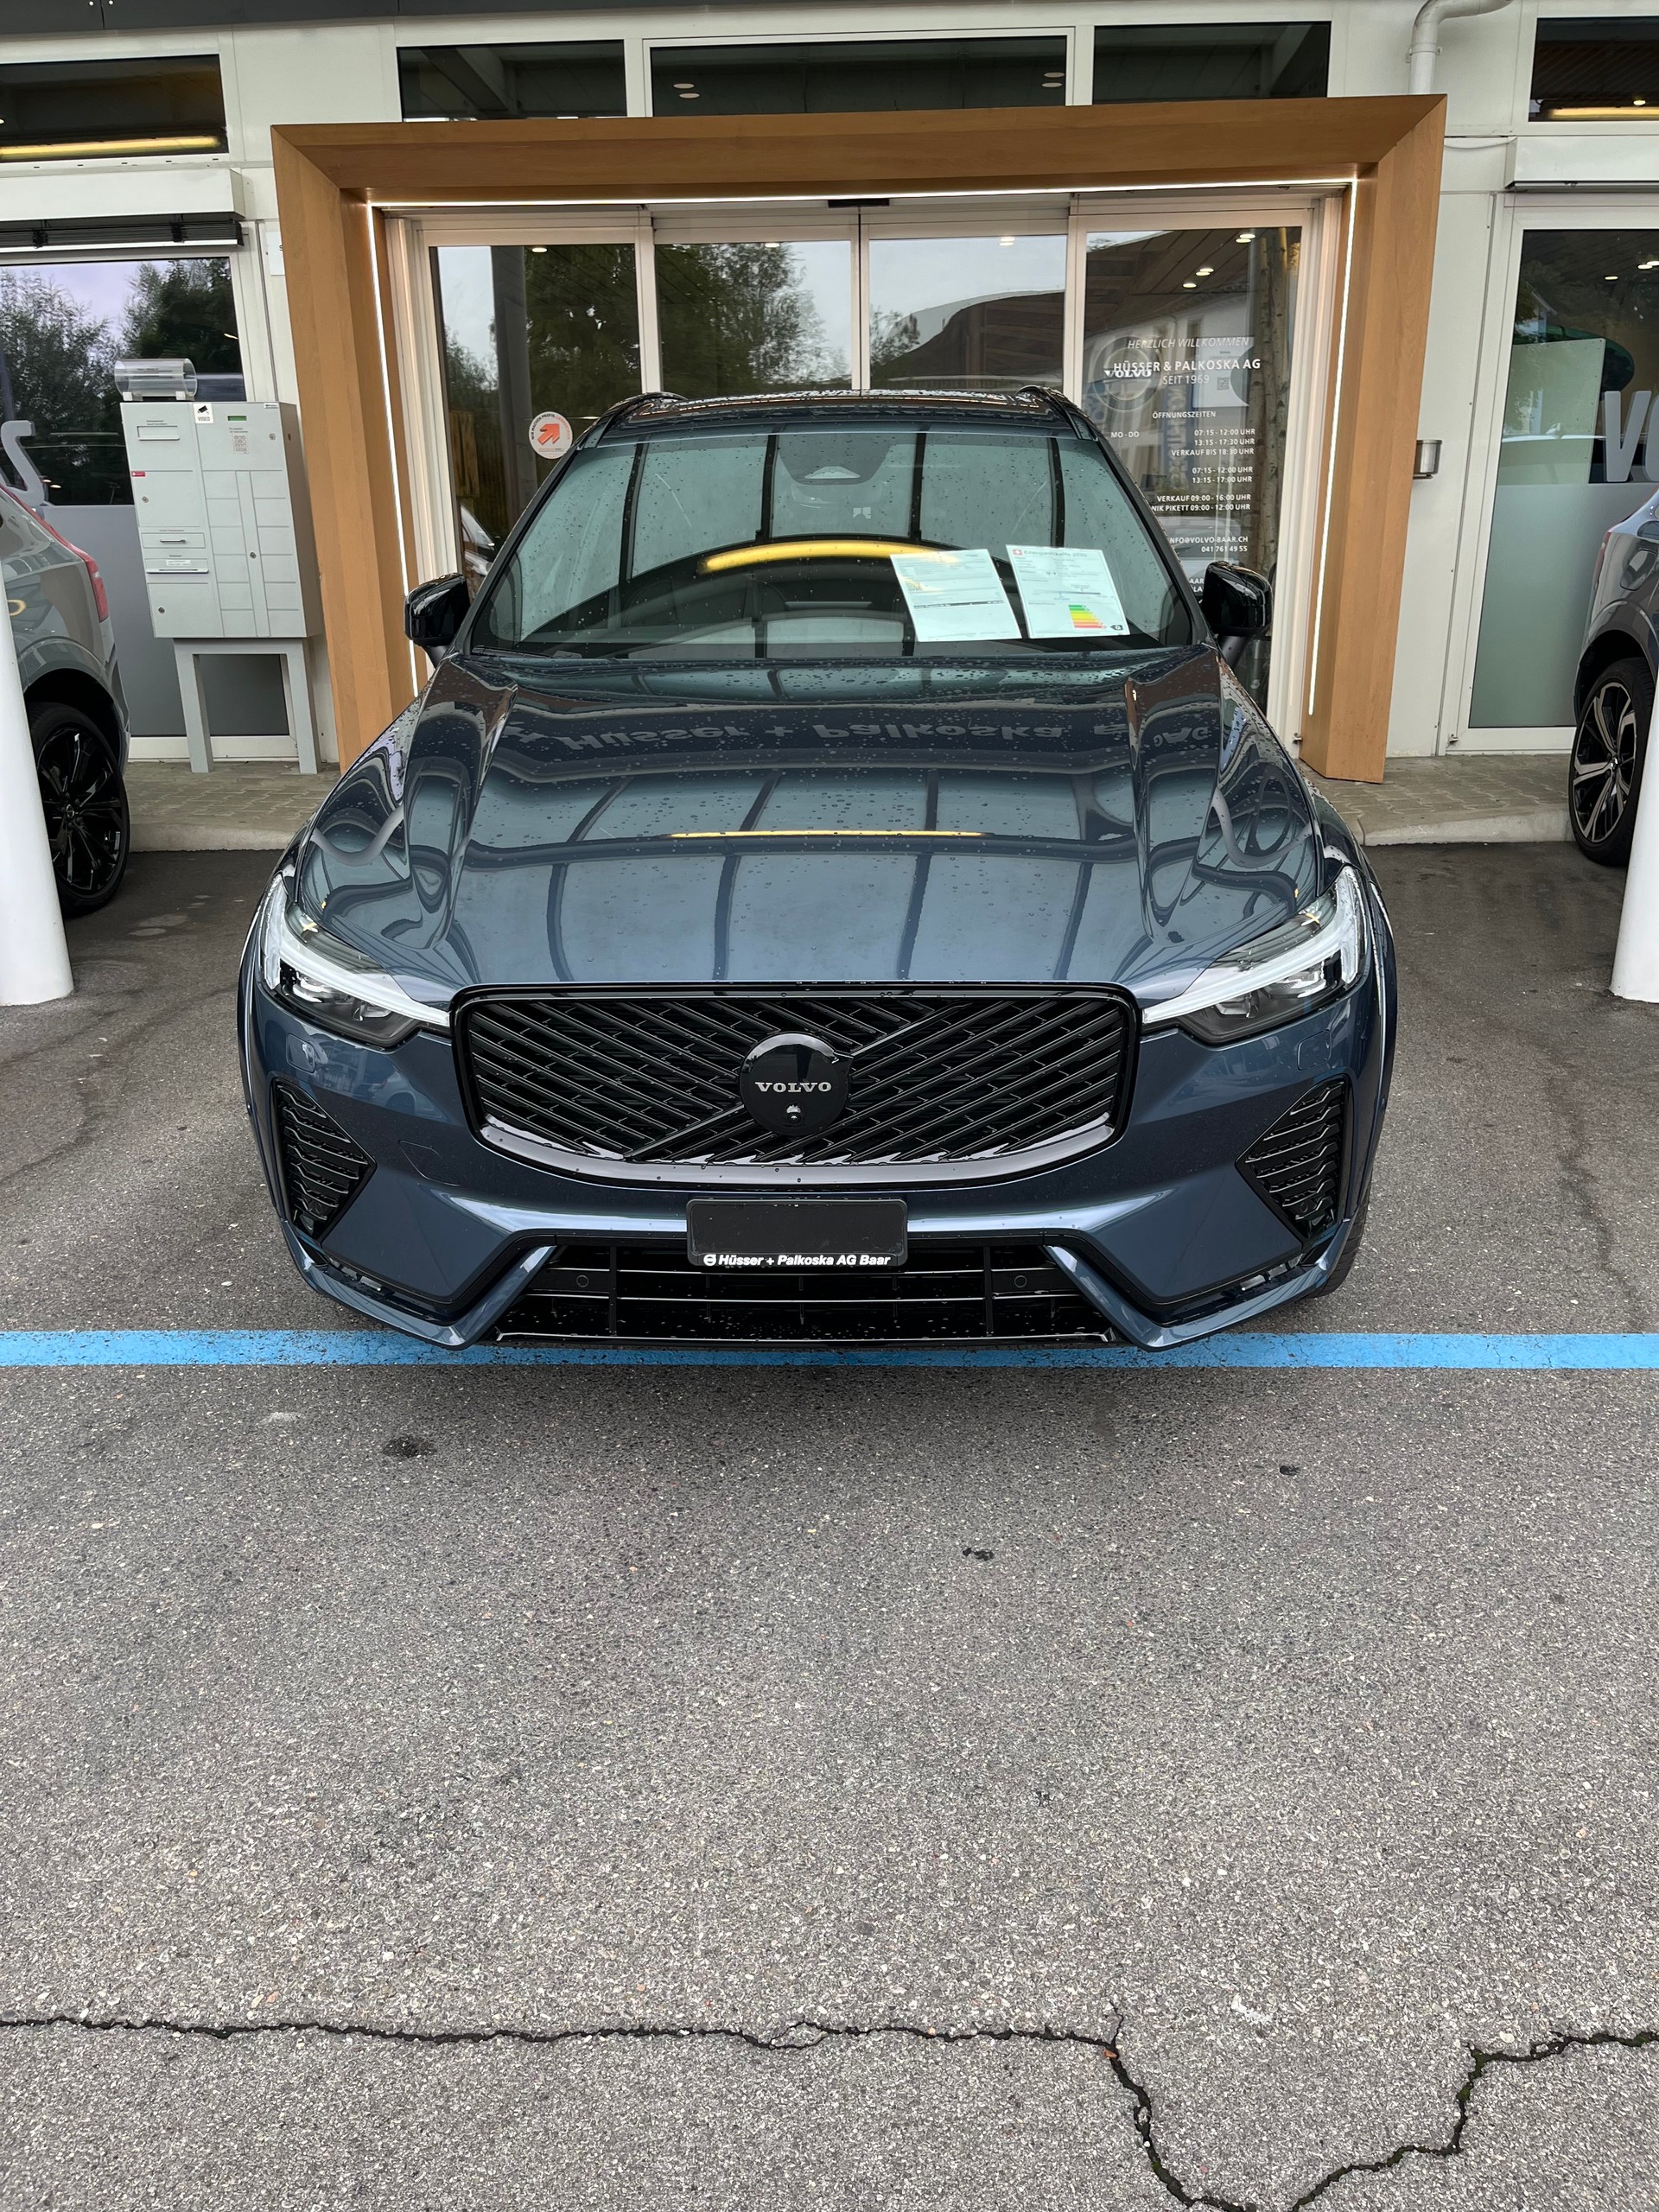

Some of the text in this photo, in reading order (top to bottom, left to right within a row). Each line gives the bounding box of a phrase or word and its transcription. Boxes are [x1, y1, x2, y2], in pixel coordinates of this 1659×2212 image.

[1127, 337, 1249, 349] HERZLICH WILLKOMMEN
[1113, 359, 1261, 372] HÜSSER & PALKOSKA AG
[1103, 369, 1152, 378] VOLVO
[1163, 374, 1210, 385] SEIT 1969
[755, 1082, 832, 1093] VOLVO
[718, 1255, 765, 1266] Hüsser
[778, 1255, 834, 1266] Palkoska
[836, 1255, 857, 1266] AG
[860, 1255, 891, 1266] Baar
